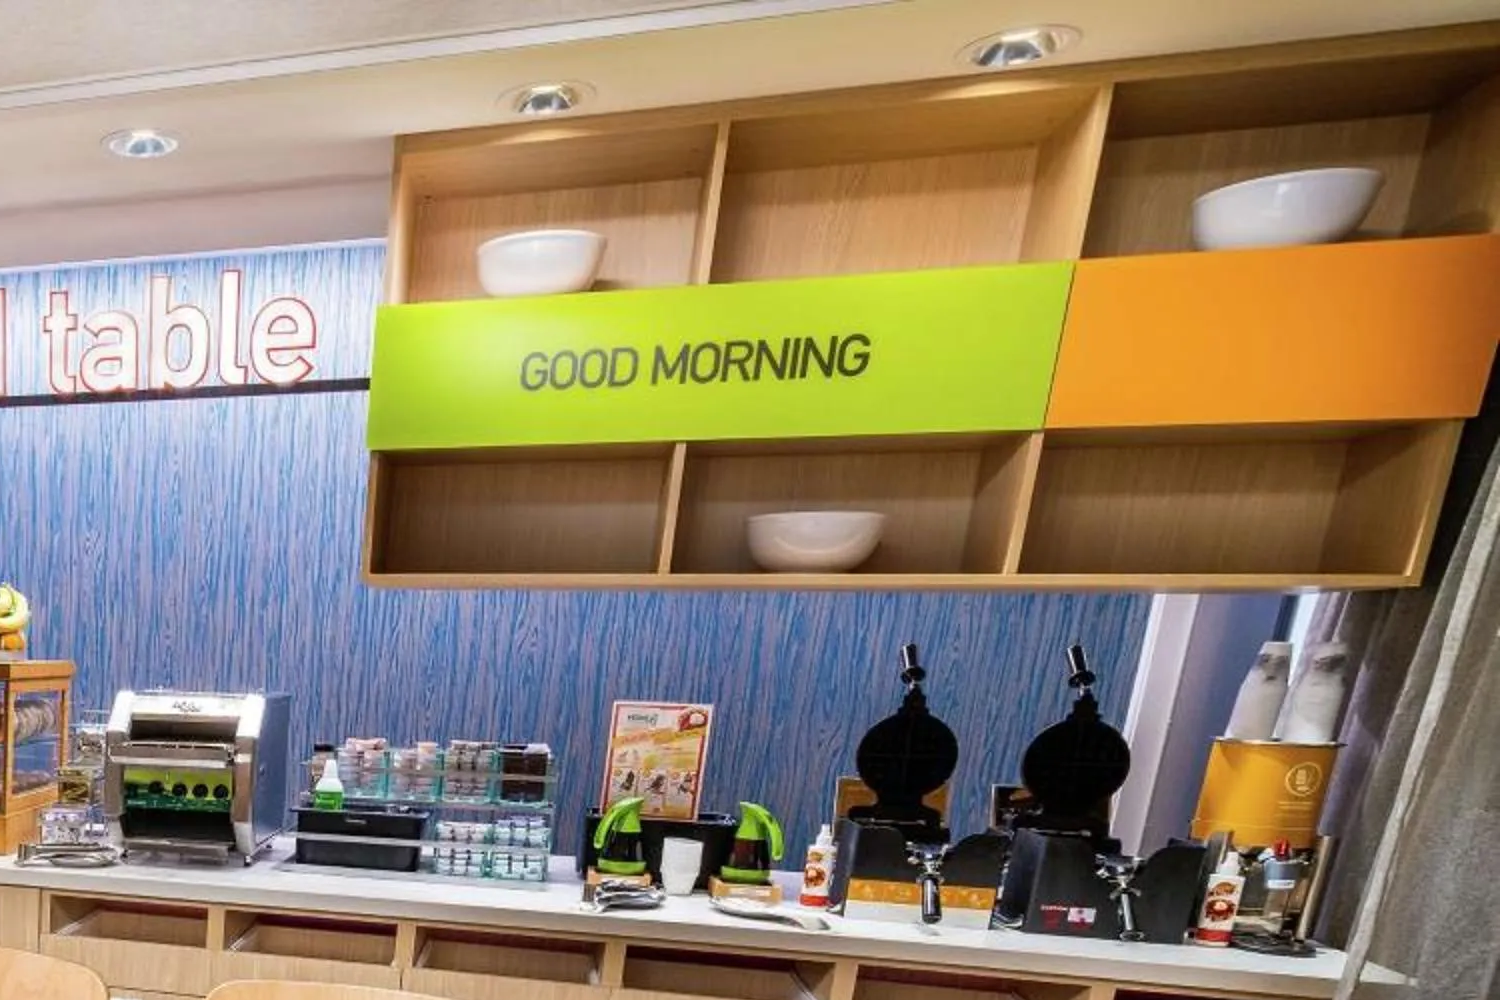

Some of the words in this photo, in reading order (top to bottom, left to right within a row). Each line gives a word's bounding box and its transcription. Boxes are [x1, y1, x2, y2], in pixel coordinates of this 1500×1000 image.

[43, 269, 317, 396] table
[520, 347, 639, 391] GOOD
[651, 333, 872, 386] MORNING
